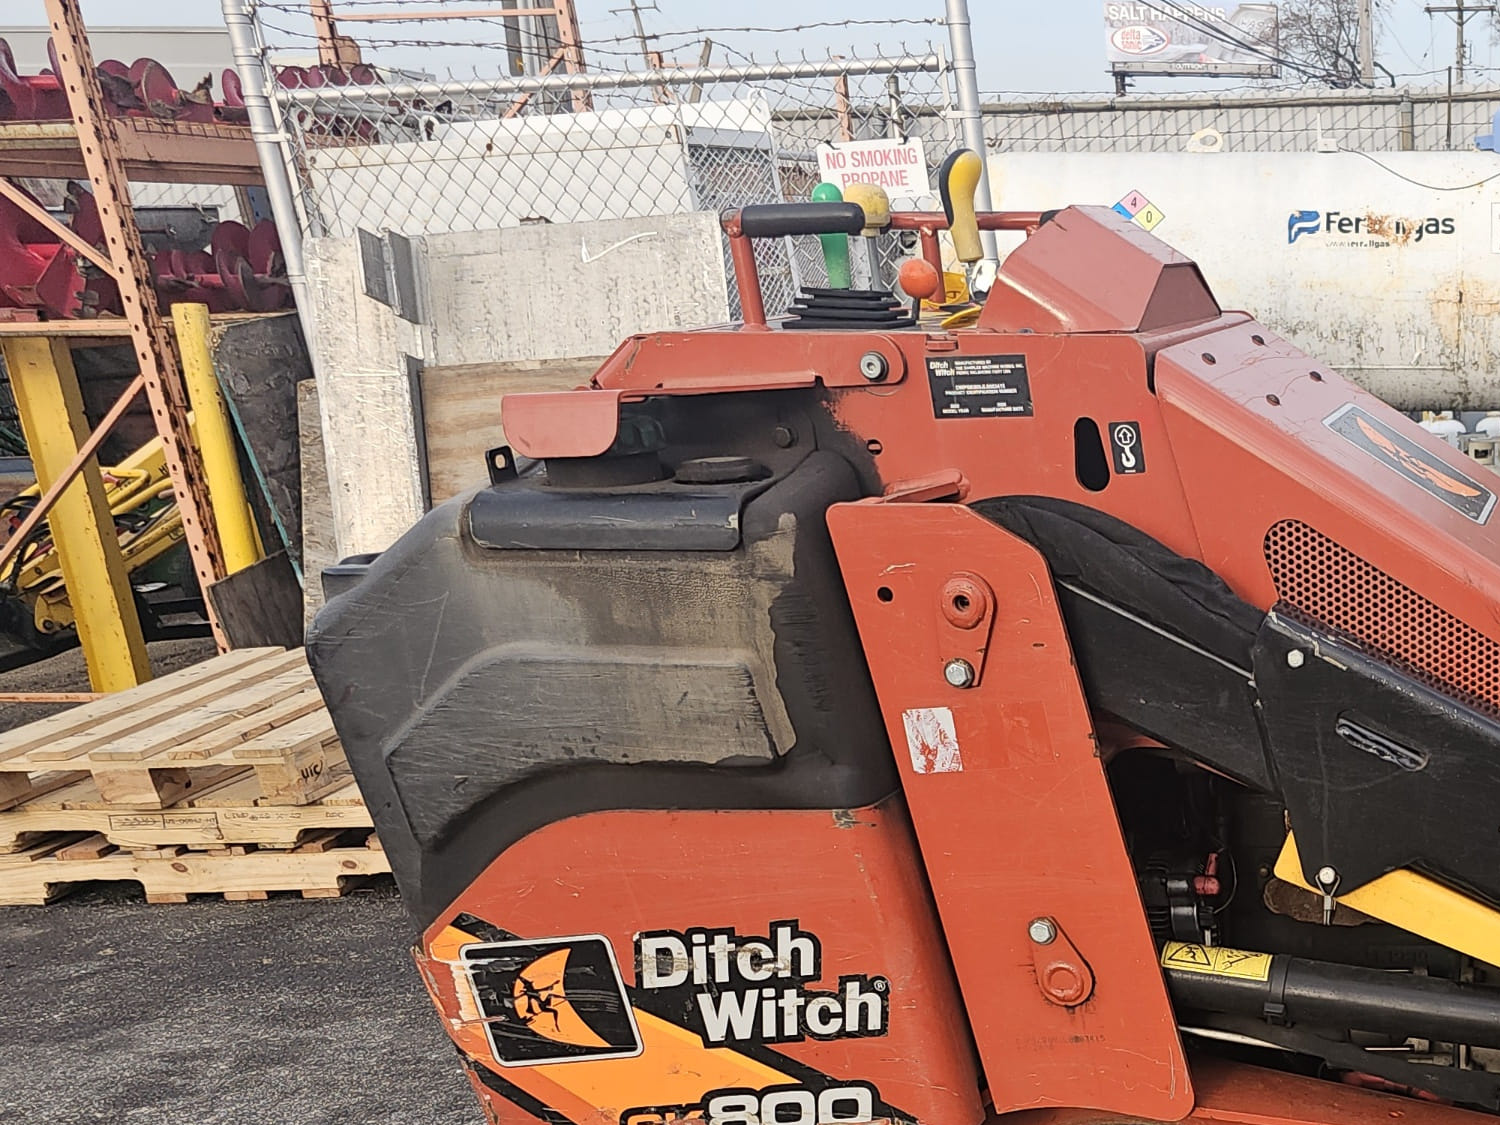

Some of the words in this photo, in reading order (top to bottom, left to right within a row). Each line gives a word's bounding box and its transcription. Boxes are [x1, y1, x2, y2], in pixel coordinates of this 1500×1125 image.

[1109, 5, 1147, 20] SALT
[1151, 6, 1227, 22] HAPPENS
[825, 151, 847, 170] NO
[850, 147, 918, 168] SMOKING
[841, 169, 909, 189] PROPANE
[1131, 196, 1137, 208] 4
[1146, 210, 1153, 223] 0
[641, 926, 815, 989] Ditch
